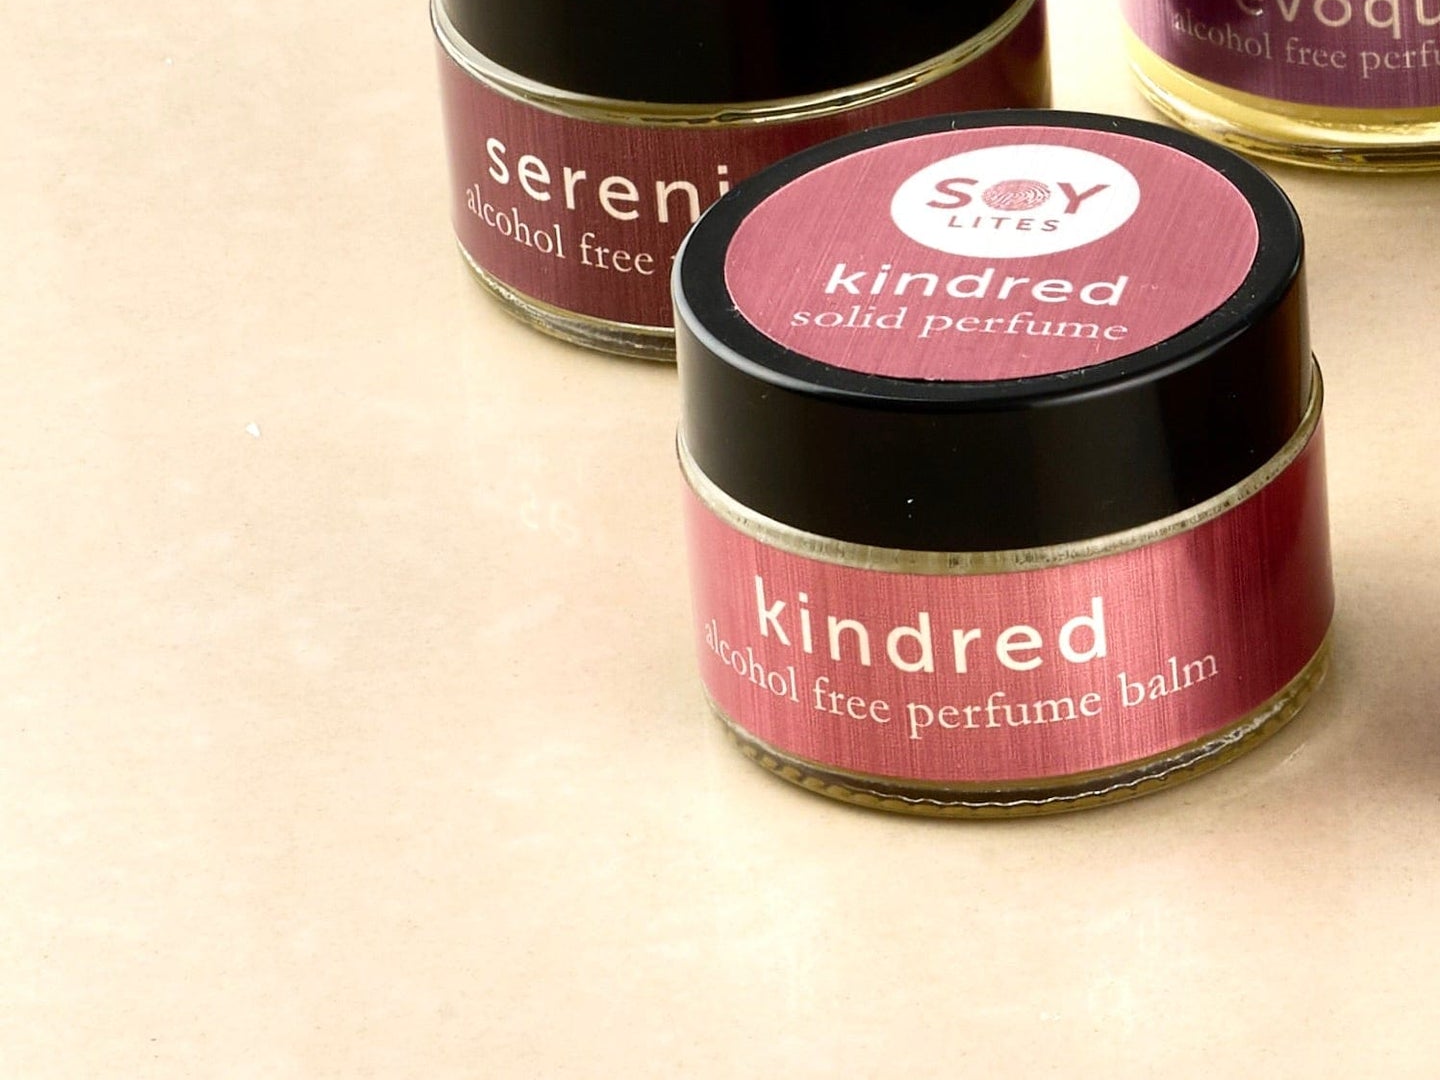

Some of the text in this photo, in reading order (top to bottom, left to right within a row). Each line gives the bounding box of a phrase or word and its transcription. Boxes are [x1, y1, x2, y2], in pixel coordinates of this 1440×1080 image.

[1171, 10, 1274, 59] alcohol
[1285, 37, 1347, 71] free
[486, 136, 731, 224] sereni
[926, 178, 1110, 213] SOY
[465, 183, 655, 276] alcohol free
[947, 214, 1059, 232] LITES
[824, 264, 1129, 307] kindred
[790, 307, 1130, 342] solid perfume
[754, 575, 1108, 674] kindred
[705, 618, 1220, 740] alcohol free perfume balm
